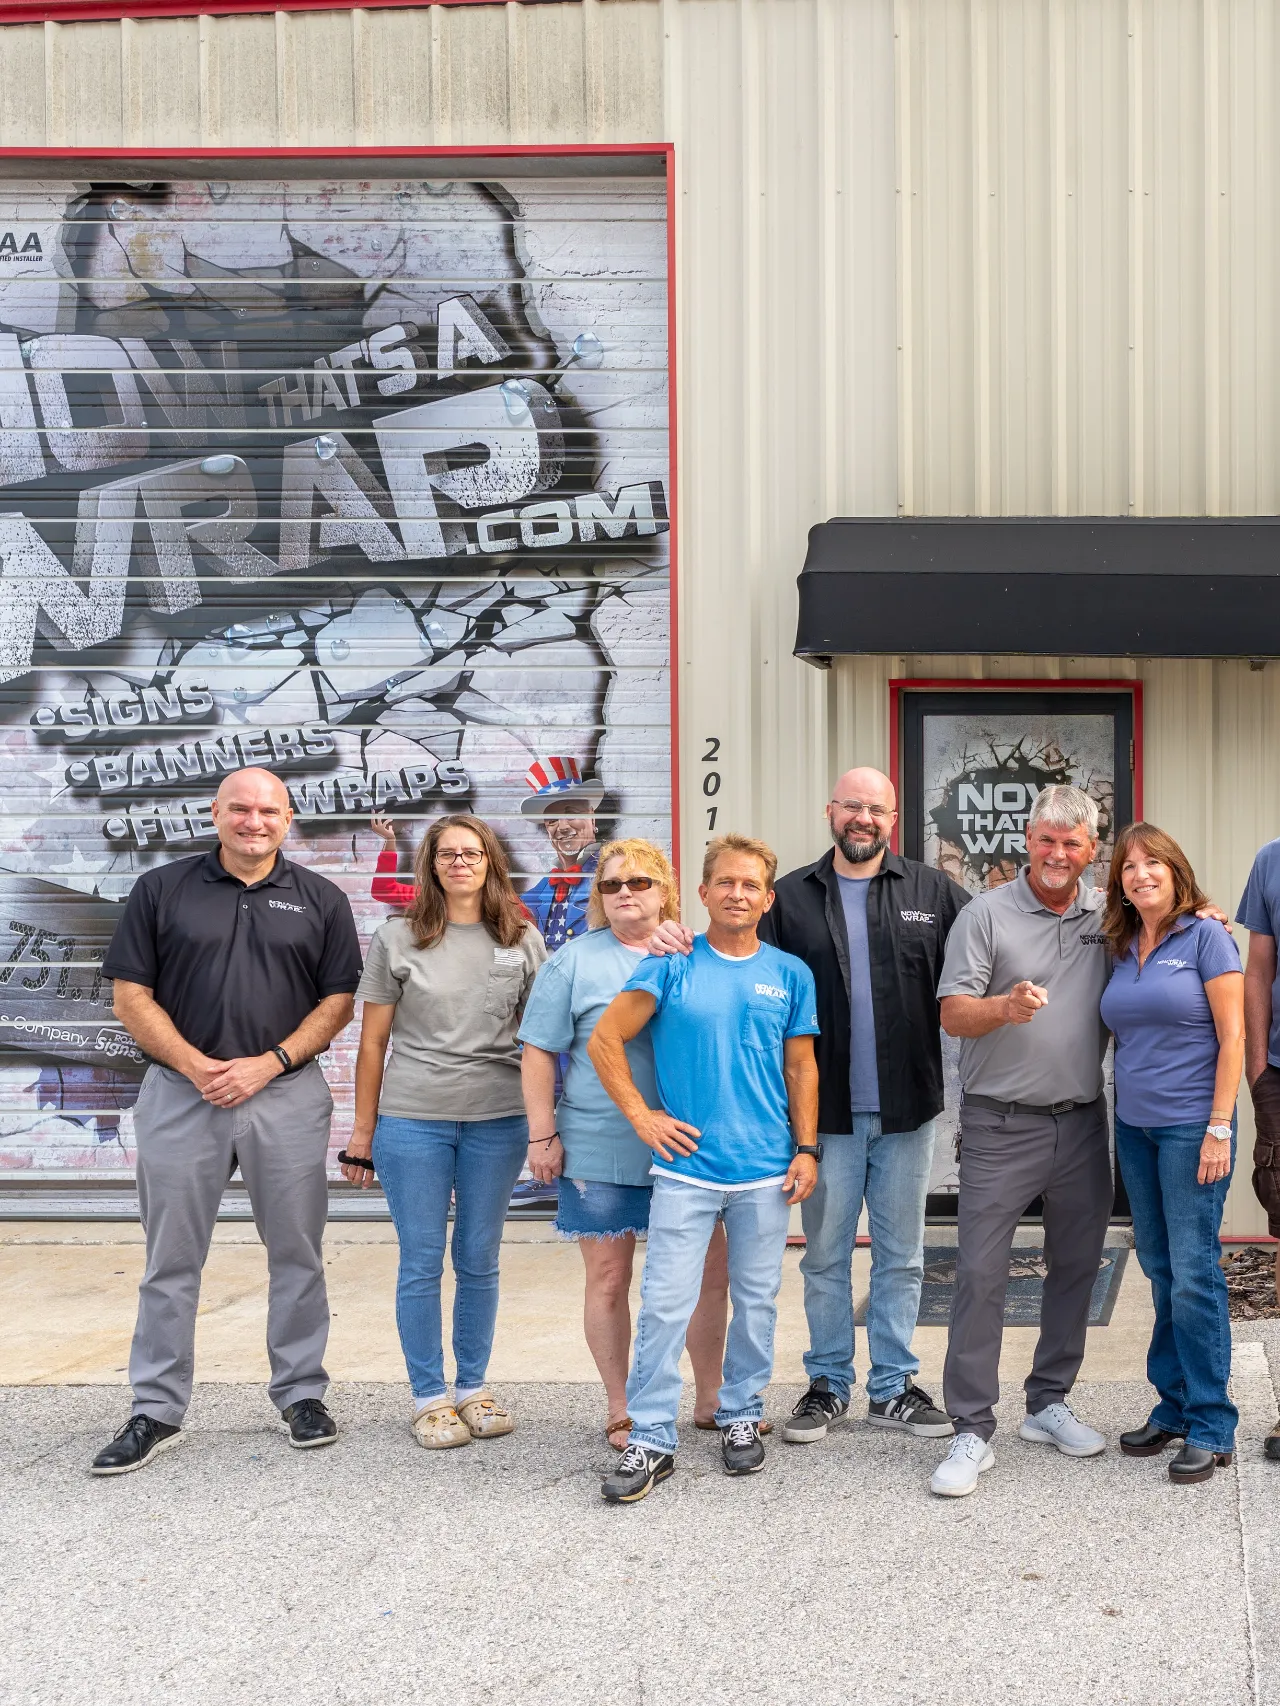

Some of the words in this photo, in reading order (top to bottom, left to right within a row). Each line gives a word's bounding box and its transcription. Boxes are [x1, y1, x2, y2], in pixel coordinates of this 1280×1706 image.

[258, 321, 430, 428] THAT'S
[437, 294, 512, 381] A
[60, 678, 214, 735] SIGNS
[95, 719, 336, 794] BANNERS
[126, 797, 216, 847] FLE
[291, 760, 471, 815] WRAPS
[701, 737, 721, 846] 201
[957, 813, 1030, 832] THAT
[961, 833, 1030, 854] WR
[13, 1016, 89, 1046] Company
[94, 1036, 136, 1057] Signs
